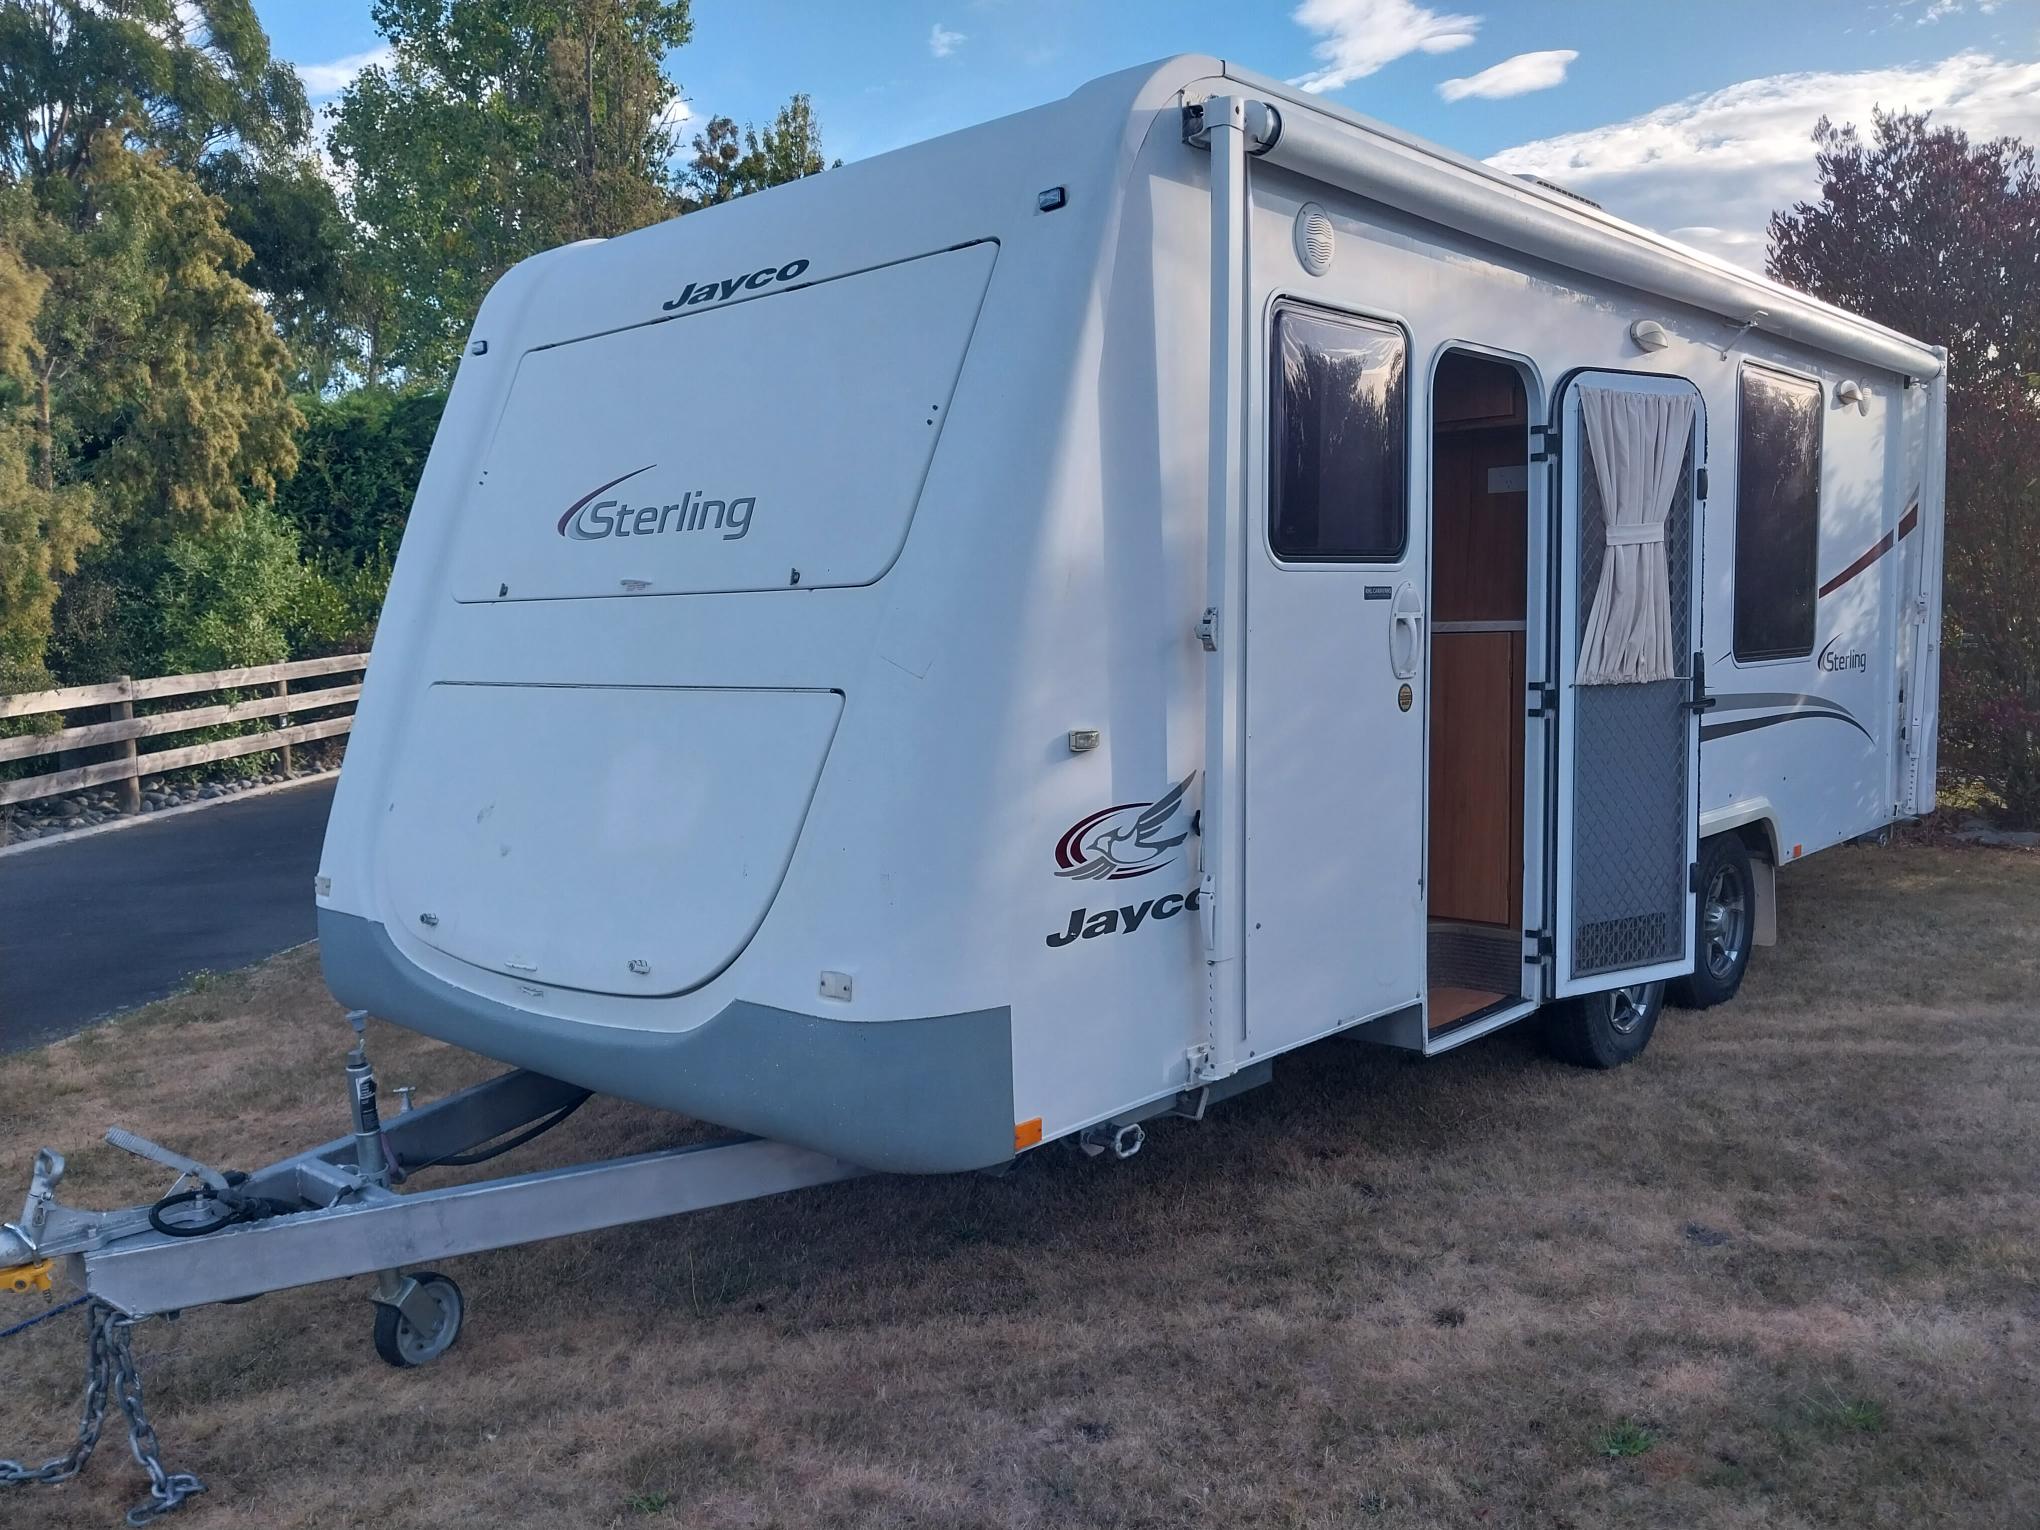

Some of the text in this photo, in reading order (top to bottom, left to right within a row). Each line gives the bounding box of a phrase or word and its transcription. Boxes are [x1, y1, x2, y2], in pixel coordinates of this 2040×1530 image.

[662, 259, 810, 311] Jayco
[574, 490, 757, 541] Sterling
[1823, 649, 1867, 673] Sterling
